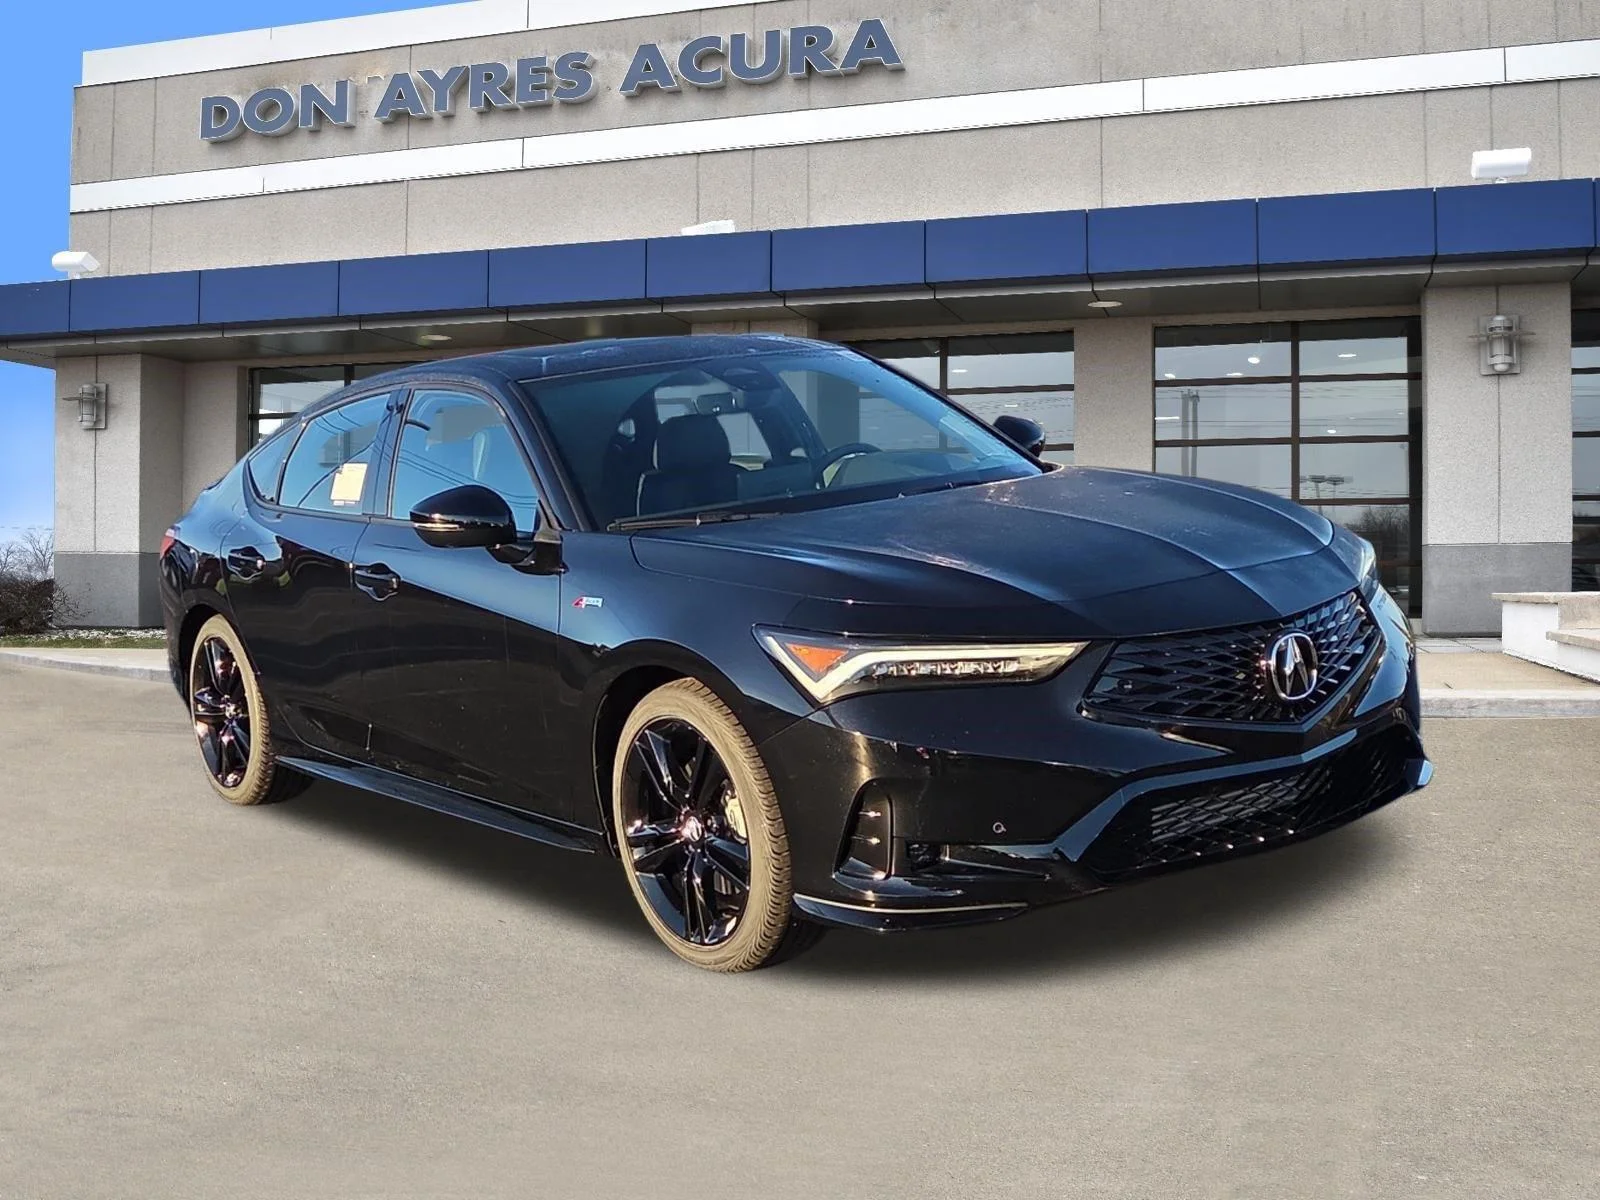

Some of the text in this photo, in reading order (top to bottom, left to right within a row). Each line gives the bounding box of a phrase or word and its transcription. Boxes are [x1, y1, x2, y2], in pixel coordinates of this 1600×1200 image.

[200, 17, 904, 142] DON AYRES ACURA
